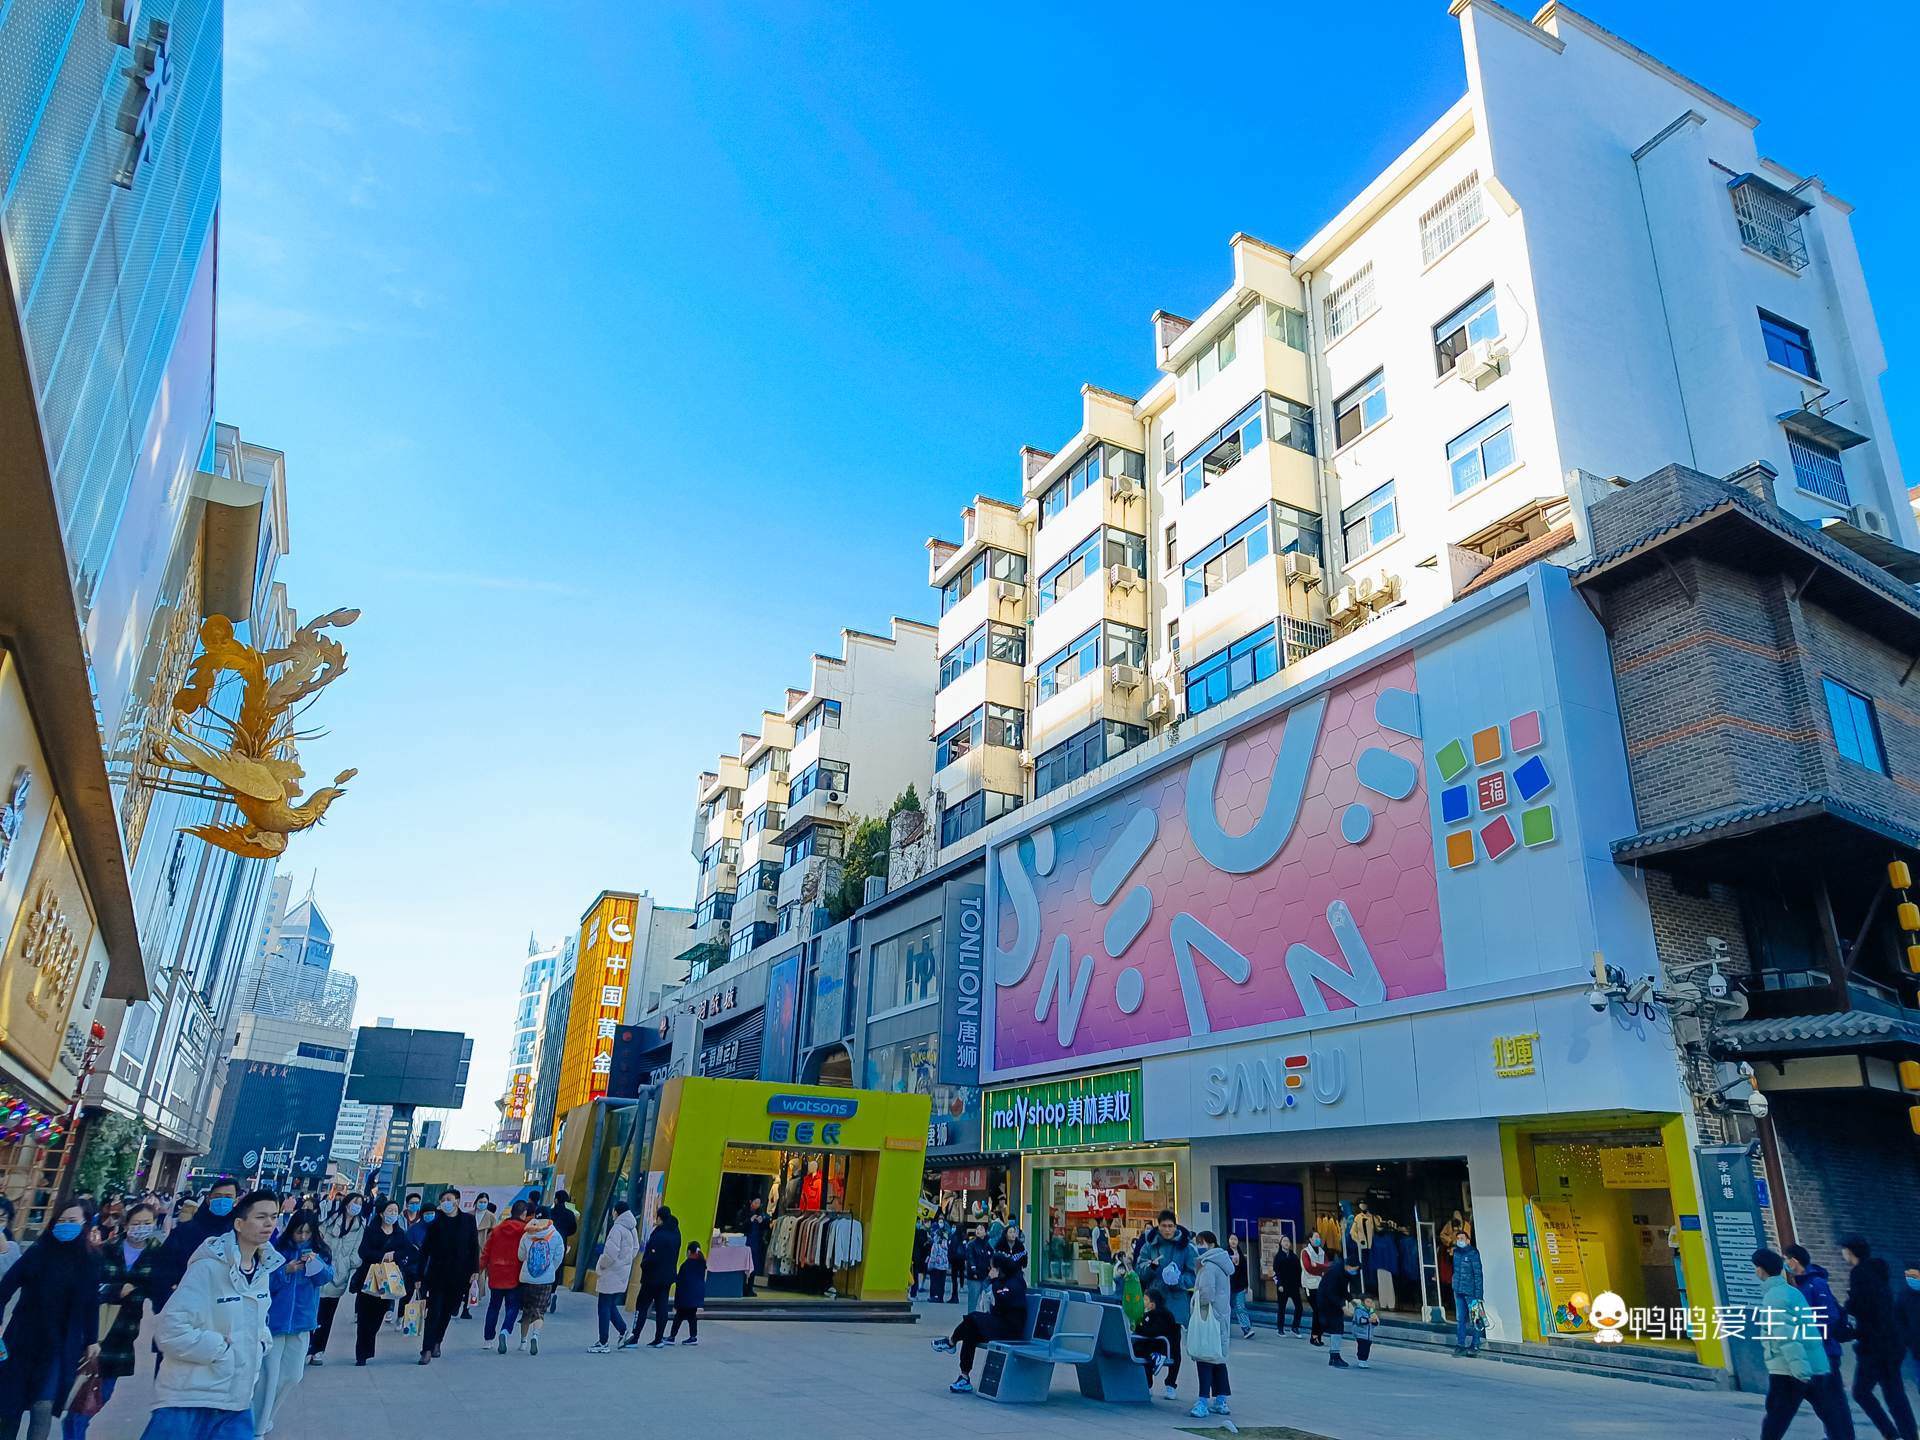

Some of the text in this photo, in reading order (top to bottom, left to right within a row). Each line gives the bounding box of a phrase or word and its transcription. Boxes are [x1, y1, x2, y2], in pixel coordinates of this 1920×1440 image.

[1480, 777, 1504, 805] 三福
[957, 897, 981, 1069] TONLION 唐狮
[592, 954, 627, 1074] 中国黄金
[1204, 1048, 1346, 1116] SANFU
[783, 1099, 847, 1115] watsons
[1068, 1090, 1130, 1127] 美林美妆
[769, 1120, 841, 1144] 屈臣氏
[926, 1122, 948, 1147] 唐狮
[1717, 1160, 1734, 1199] 李府巷
